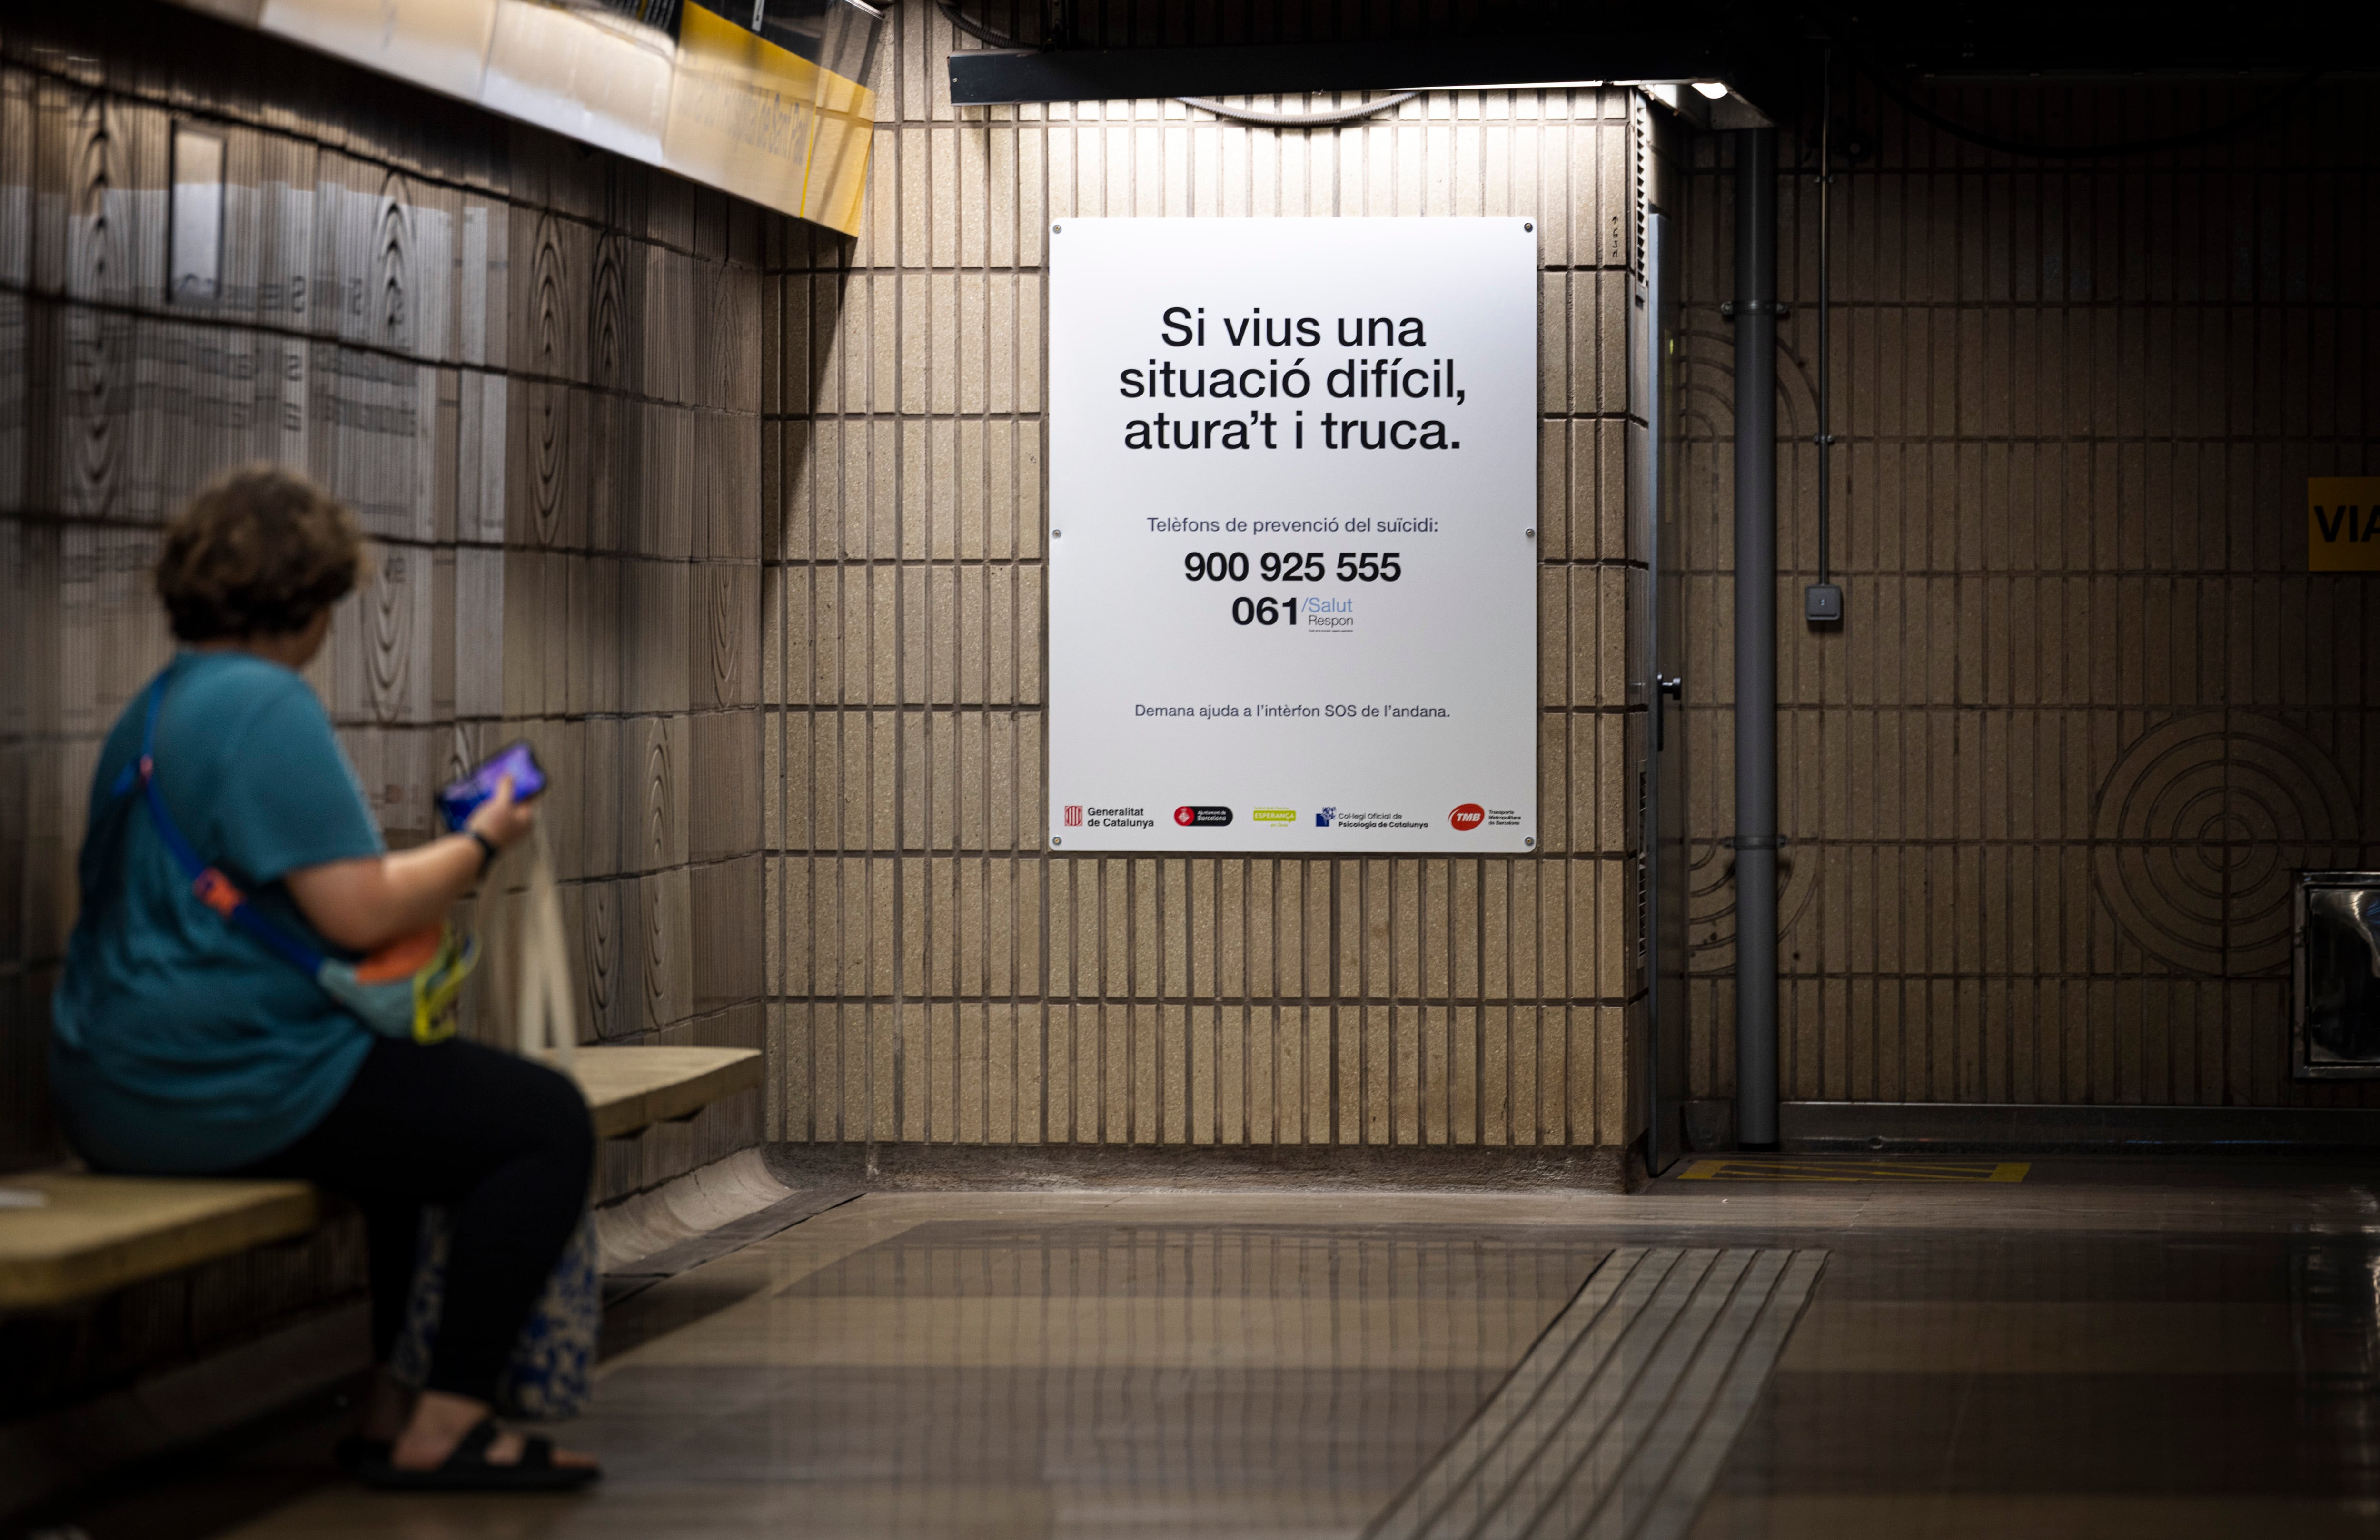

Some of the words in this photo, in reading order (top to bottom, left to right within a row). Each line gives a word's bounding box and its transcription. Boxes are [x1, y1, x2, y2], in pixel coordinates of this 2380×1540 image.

[1162, 307, 1204, 346] Si
[1224, 308, 1320, 346] vius
[1338, 317, 1426, 346] una
[1120, 358, 1310, 398] situació
[1327, 358, 1465, 405] difícil,
[1296, 411, 1302, 449] i
[1321, 413, 1459, 450] truca.
[1147, 518, 1220, 532] Telèfons
[1226, 518, 1247, 532] de
[1254, 518, 1339, 535] prevenció
[1345, 518, 1370, 532] del
[1377, 518, 1438, 532] suïcidi:
[1185, 552, 1249, 581] 900
[1261, 552, 1325, 582] 925
[1337, 553, 1401, 582] 555
[1232, 597, 1296, 625] 061
[1309, 615, 1353, 628] Respon
[1136, 705, 1194, 716] Demana
[1200, 705, 1239, 719] ajuda
[1244, 708, 1252, 716] a
[1325, 705, 1357, 717] SOS
[1362, 705, 1379, 717] de
[1088, 808, 1143, 816] Generalitat
[1457, 813, 1480, 822] TMB
[1103, 819, 1153, 829] Catalunya
